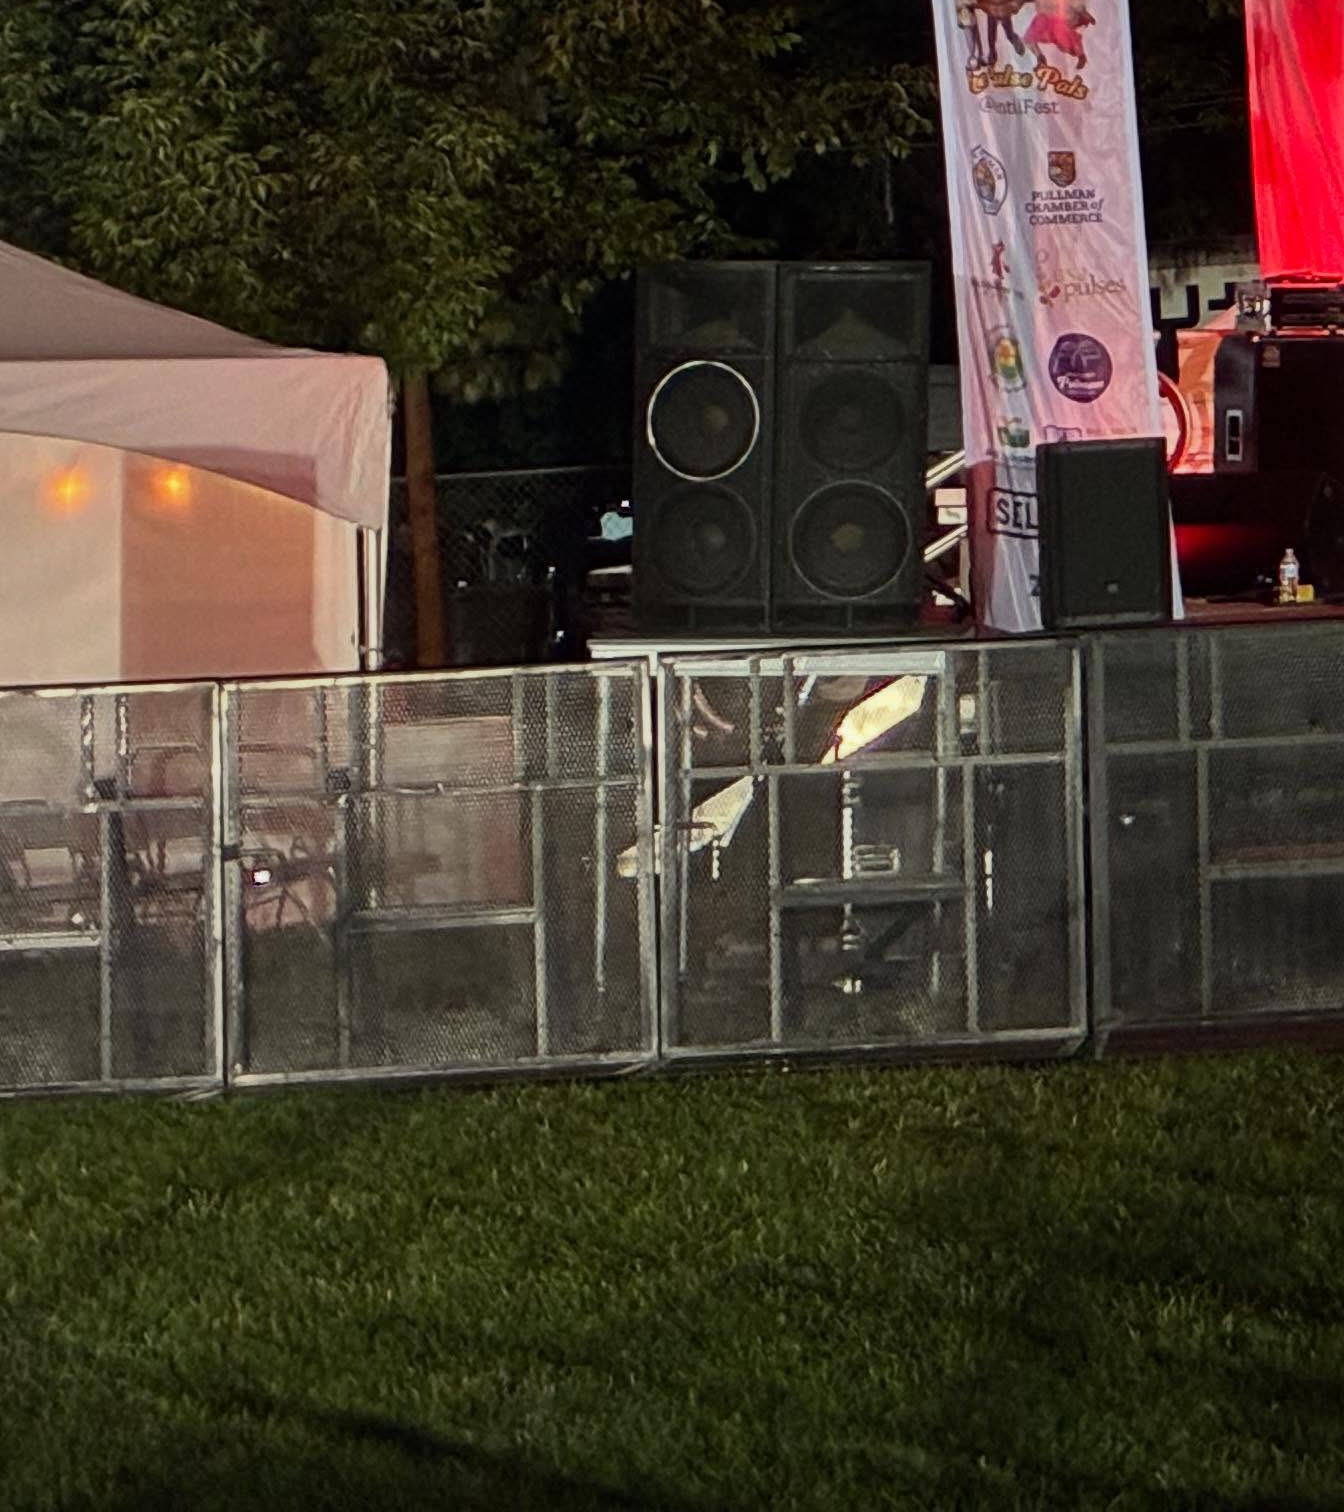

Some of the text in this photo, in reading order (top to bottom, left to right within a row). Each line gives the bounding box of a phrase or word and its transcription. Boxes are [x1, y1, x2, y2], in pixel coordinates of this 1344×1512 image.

[1034, 65, 1089, 101] Pals
[1032, 189, 1096, 201] PULLMAN
[1025, 198, 1104, 213] CHAMBER of
[1029, 213, 1104, 226] COMMERCE
